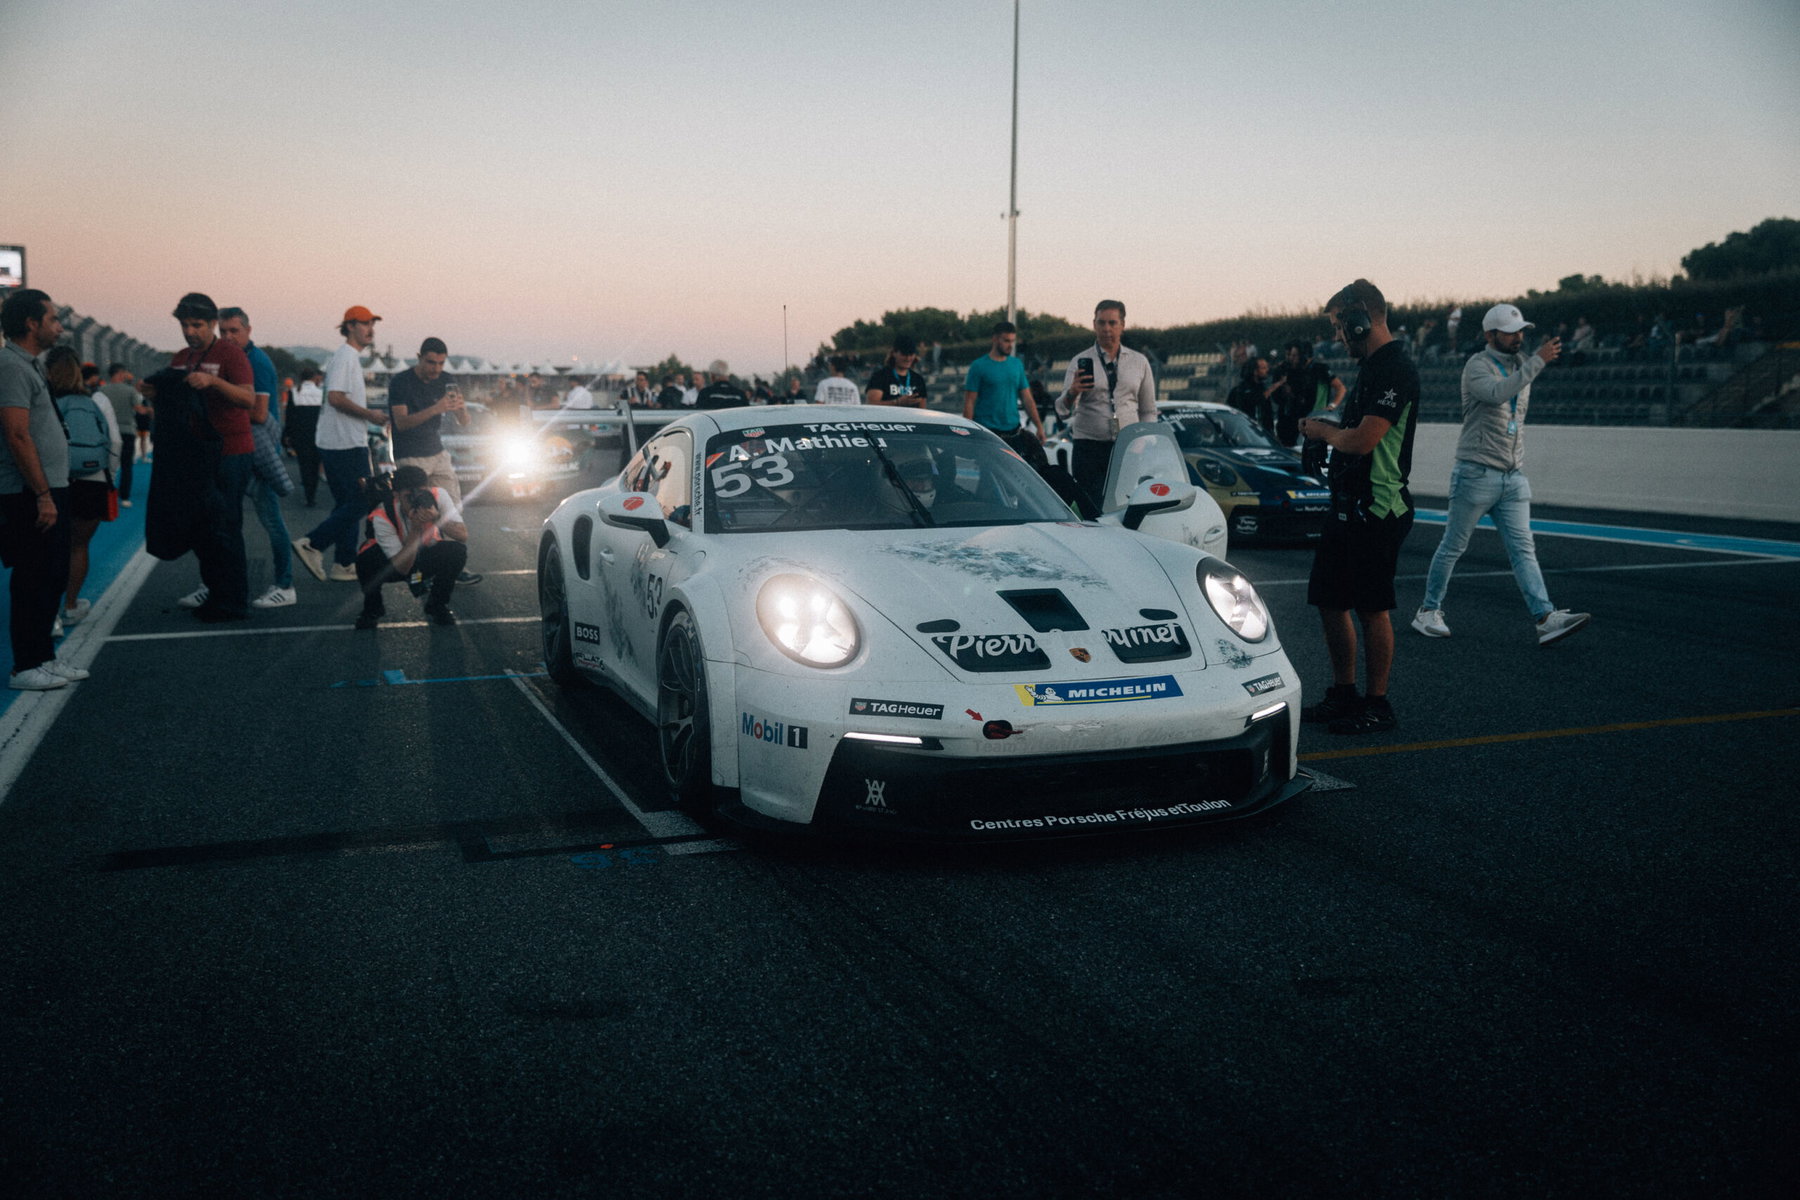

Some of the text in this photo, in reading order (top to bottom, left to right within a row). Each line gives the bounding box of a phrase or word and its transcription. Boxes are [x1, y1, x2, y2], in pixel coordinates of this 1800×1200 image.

[729, 436, 887, 462] A. Mathieu
[711, 455, 794, 499] 53
[647, 573, 662, 619] 53
[576, 626, 599, 641] BOSS
[935, 634, 1039, 660] Pierr
[1068, 682, 1166, 699] MICHELIN
[1254, 674, 1284, 691] TAGHeuer
[871, 701, 940, 717] TAGHeuer
[742, 712, 801, 747] Mobil 1
[970, 818, 1044, 832] Centres
[1045, 812, 1118, 827] Porsche
[1118, 805, 1168, 823] Fréjus
